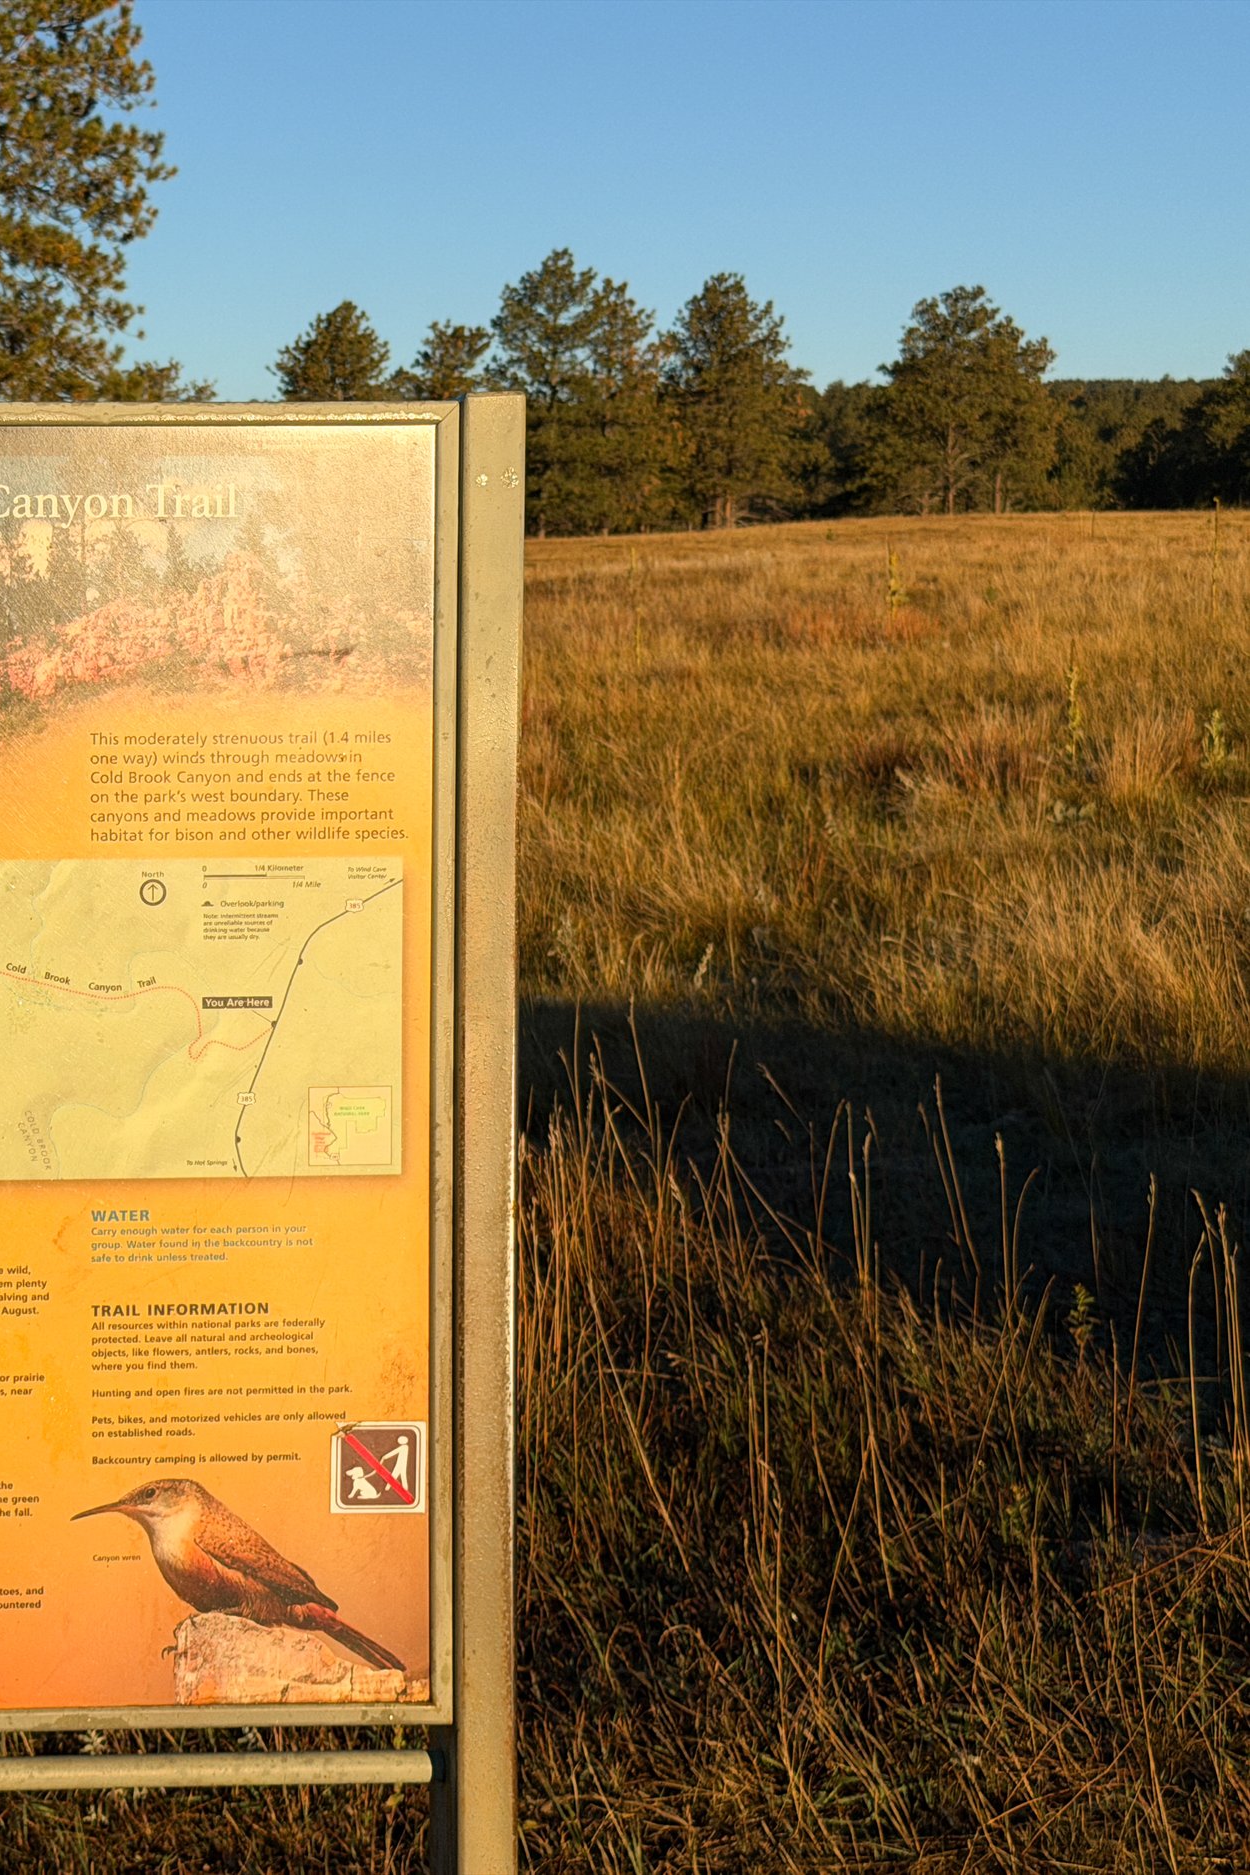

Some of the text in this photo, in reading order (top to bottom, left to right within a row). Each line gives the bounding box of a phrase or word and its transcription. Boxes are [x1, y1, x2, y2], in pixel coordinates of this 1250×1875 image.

[145, 482, 238, 519] Trail
[89, 731, 391, 748] This moderately strenuous trail (1.4 miles
[89, 751, 362, 767] one way) winds through meadows in
[90, 769, 395, 786] Cold Brook Canyon and ends at the fence
[89, 793, 109, 803] on
[114, 790, 138, 803] the
[190, 789, 224, 802] west
[229, 789, 302, 805] boundary.
[307, 788, 349, 801] These
[90, 807, 393, 826] canyons and meadows provide important
[90, 826, 408, 843] habitat for bison and other wildlife species.
[141, 870, 164, 878] North
[254, 864, 304, 872] 1/4 Kilometer
[292, 880, 321, 889] 1/4 Mile
[219, 899, 284, 908] Overlook/parking
[6, 962, 157, 993] Cold Brook Canyon Trail
[205, 997, 269, 1007] You Are Here
[240, 1095, 253, 1103] 385
[90, 1209, 149, 1222] WATER
[6, 1265, 30, 1277] wild,
[15, 1278, 47, 1290] plenty
[30, 1292, 49, 1302] and
[91, 1301, 268, 1317] TRAIL INFORMATION
[91, 1318, 325, 1330] All resources within national parks are federally
[91, 1331, 313, 1346] protected. Leave all natural and archeological
[12, 1372, 44, 1384] prairie
[91, 1384, 352, 1399] Hunting and open fires are not permitted in the park.
[91, 1452, 301, 1467] Backcountry camping is allowed by permit.
[11, 1496, 39, 1505] green
[92, 1554, 120, 1563] Canyon
[25, 1586, 44, 1596] and
